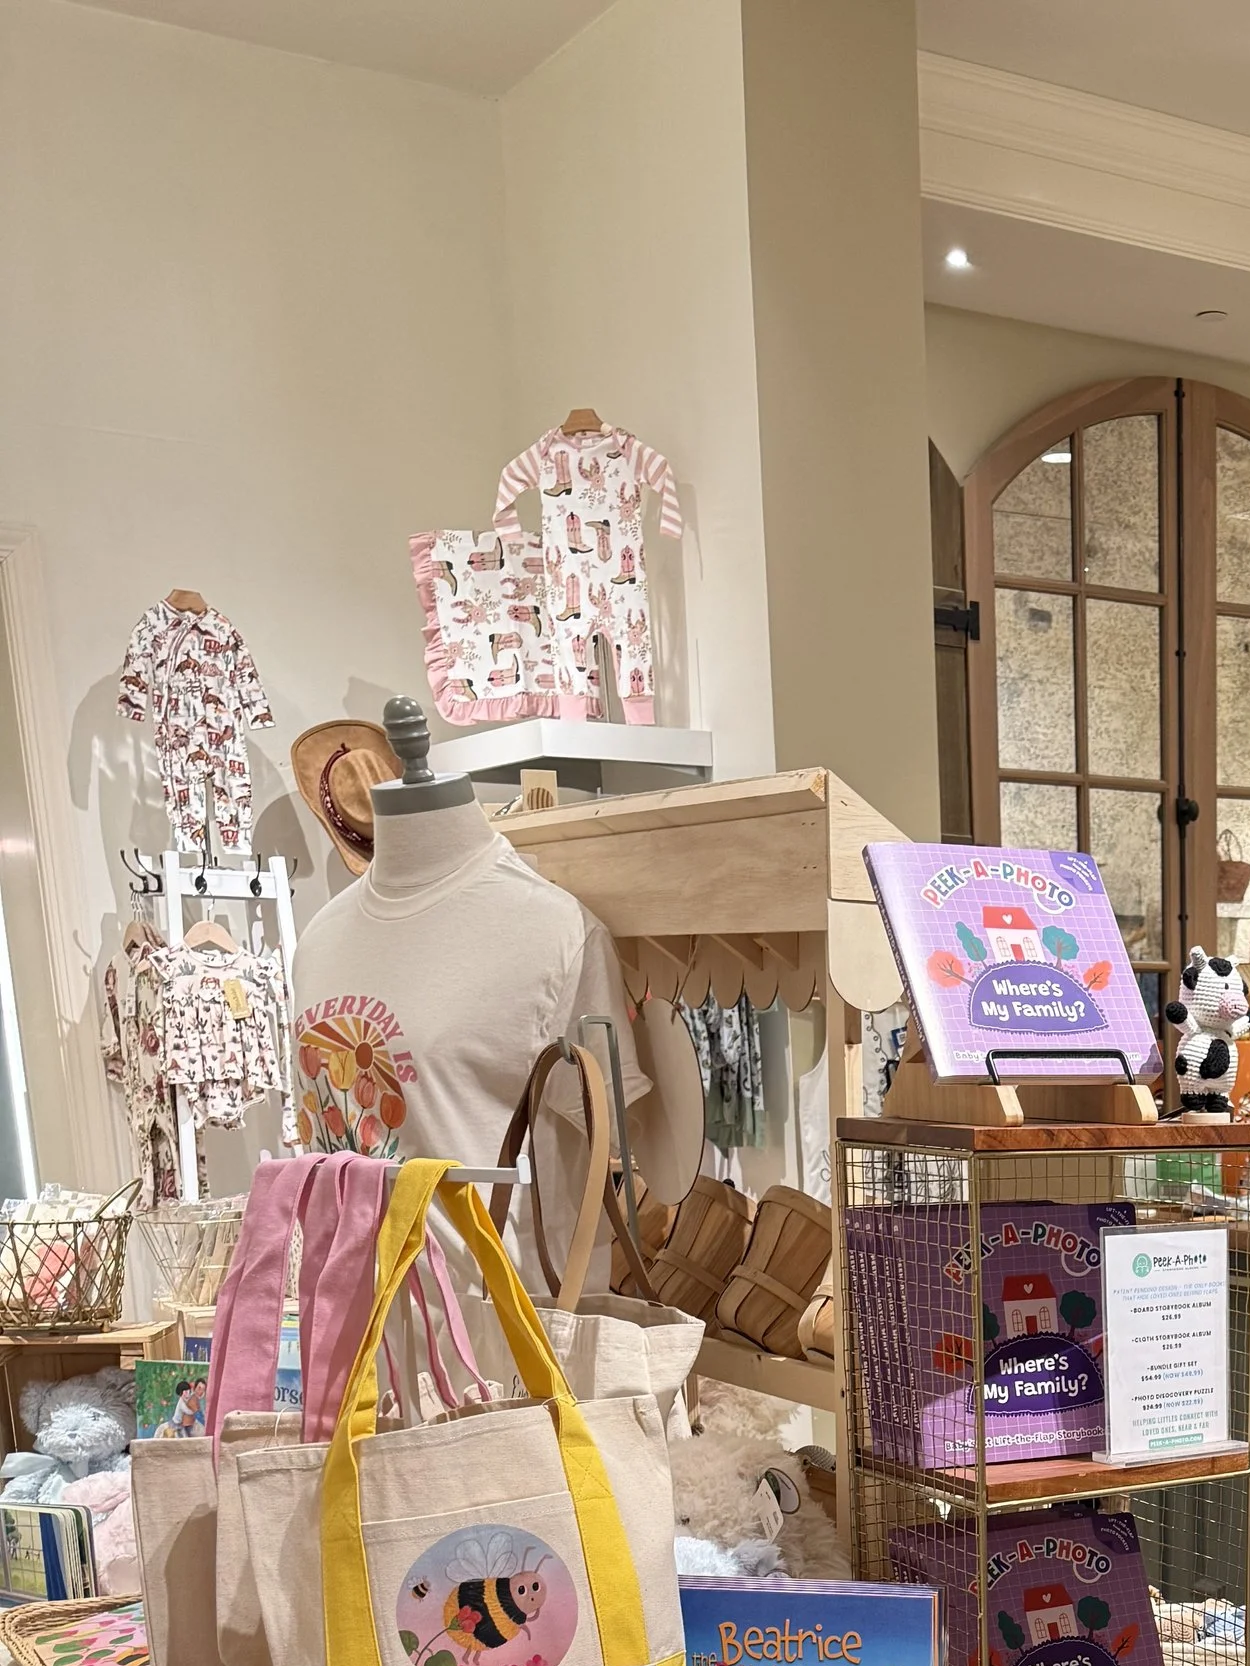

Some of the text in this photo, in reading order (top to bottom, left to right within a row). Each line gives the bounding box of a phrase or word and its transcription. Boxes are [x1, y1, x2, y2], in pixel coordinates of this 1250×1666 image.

[922, 860, 1074, 907] PEEK-A-PHOTO
[992, 979, 1064, 997] Where's
[981, 1001, 1086, 1022] My Family?
[294, 996, 418, 1083] EVERYDAY IS
[943, 1221, 1101, 1284] PEK-A-PHOTO
[1155, 1303, 1190, 1311] STORYBOOK
[1155, 1332, 1190, 1341] STORYBOOK
[1000, 1353, 1069, 1375] Where's
[1173, 1361, 1186, 1369] GIFT
[984, 1373, 1089, 1404] My Family?
[1132, 1418, 1156, 1427] HELPING
[1157, 1415, 1178, 1424] LITTLES
[1180, 1412, 1203, 1421] CONNECT
[1057, 1427, 1103, 1441] Storybook
[1142, 1427, 1159, 1436] LOVED
[1178, 1423, 1192, 1431] NEAR
[1101, 1527, 1116, 1535] PHOTO
[968, 1538, 1111, 1591] EK-A-PHOTO
[719, 1618, 863, 1666] Beatrice
